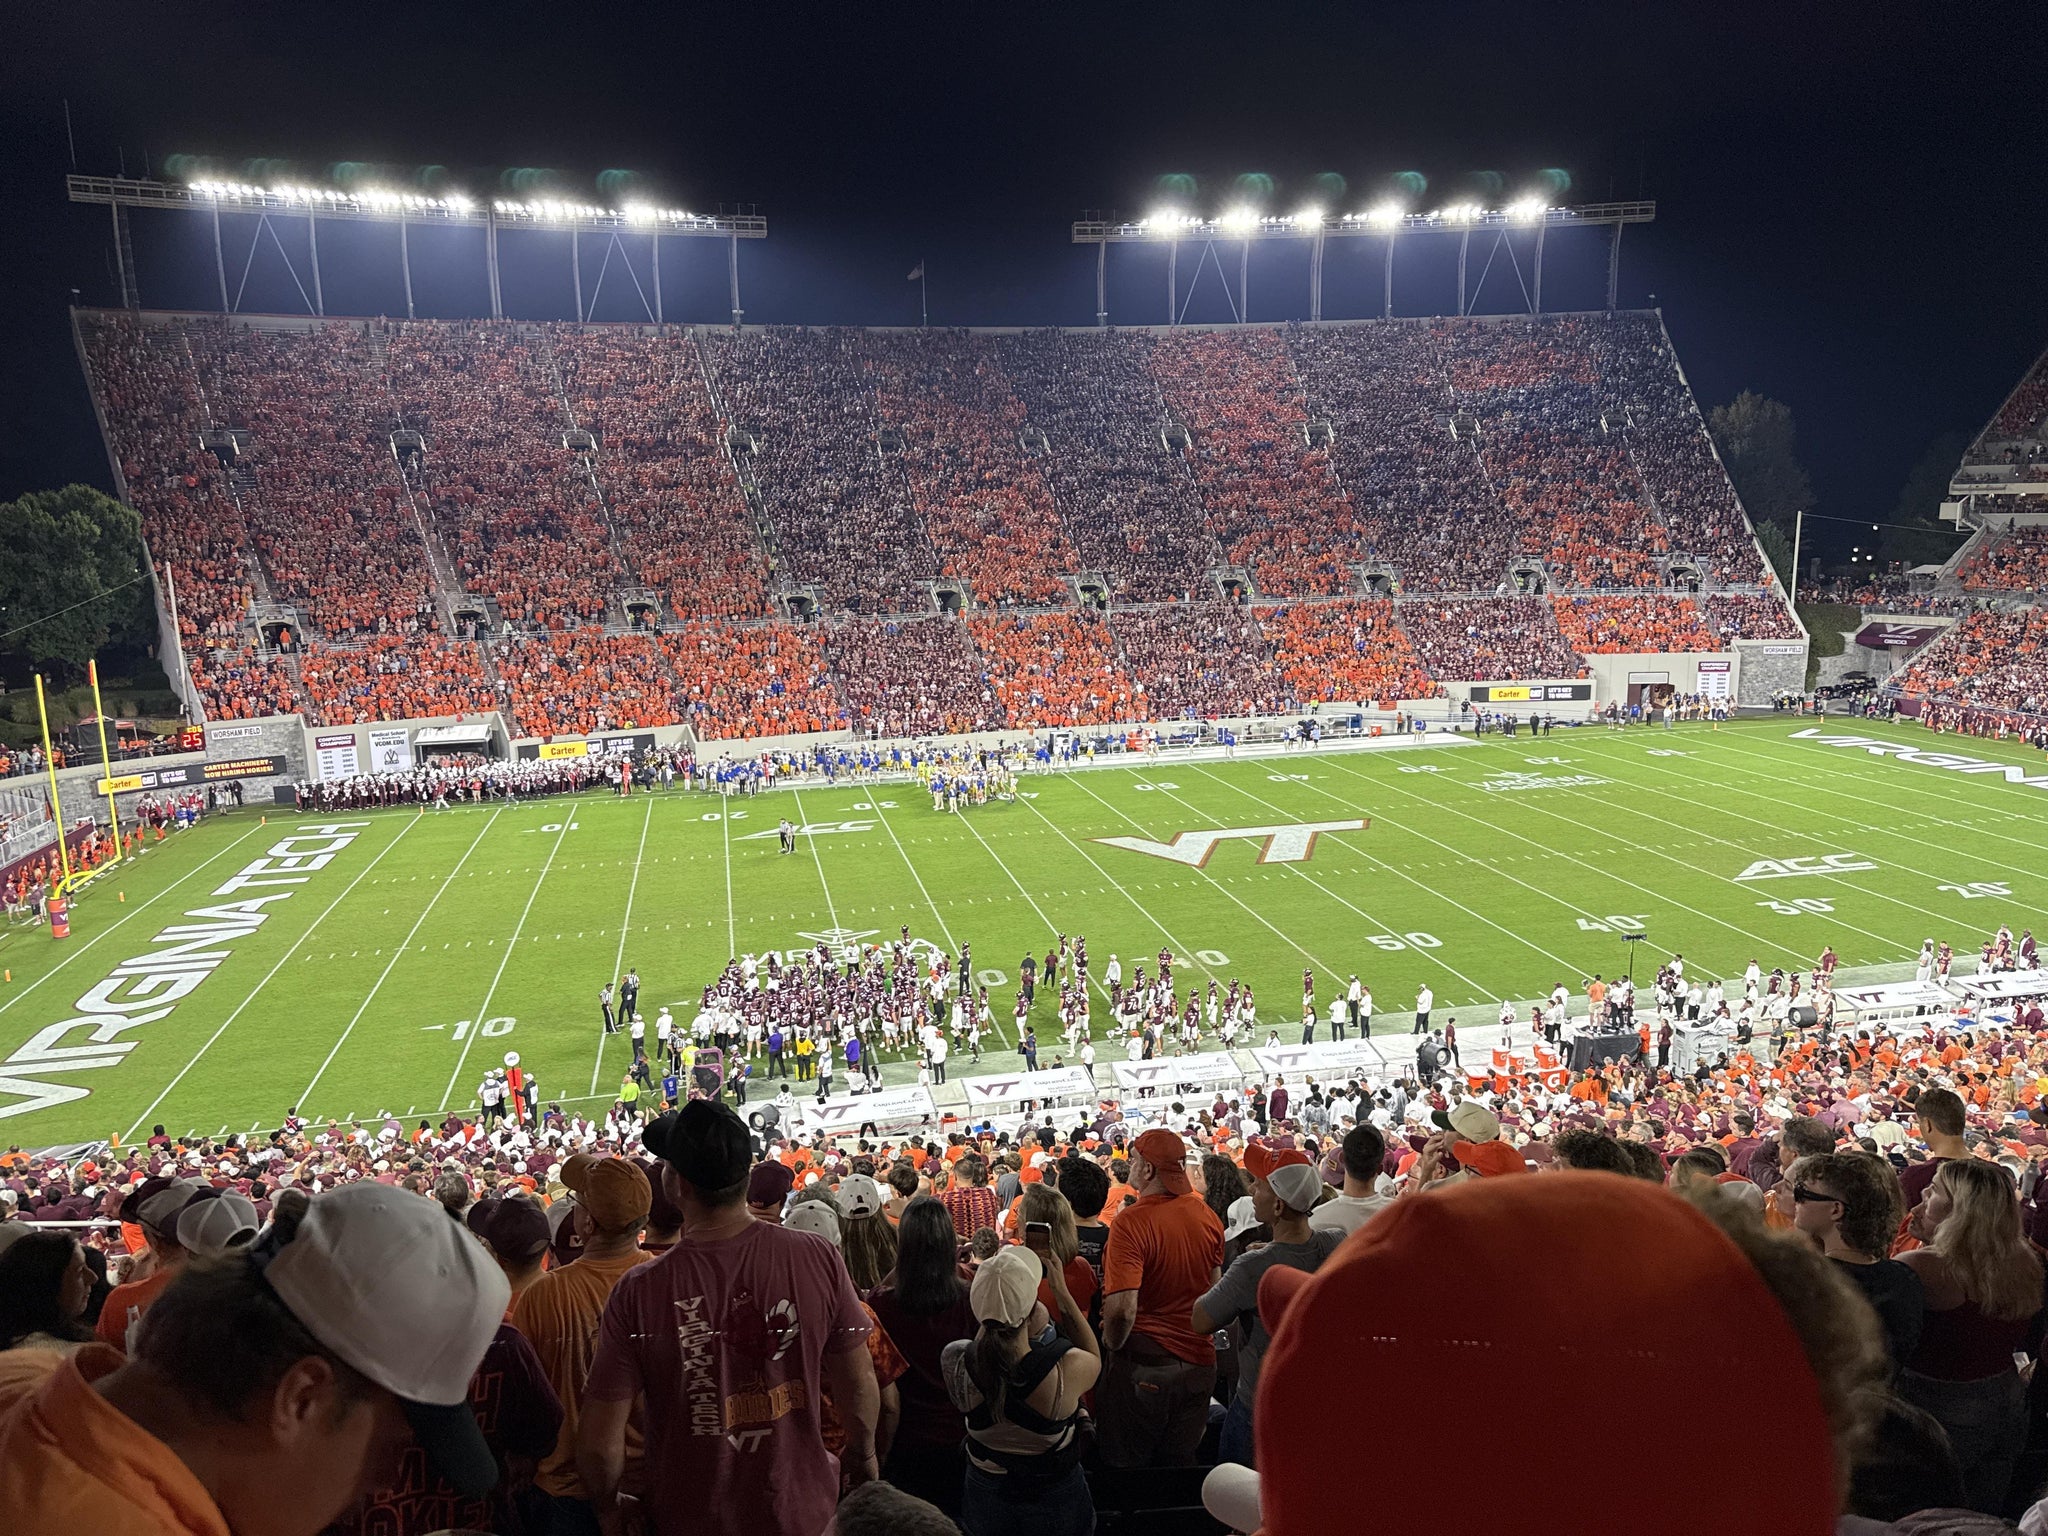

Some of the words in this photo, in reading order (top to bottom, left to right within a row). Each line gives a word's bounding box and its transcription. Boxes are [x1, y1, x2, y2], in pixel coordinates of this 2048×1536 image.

[1885, 624, 1938, 635] VT
[1498, 690, 1520, 698] Carter
[183, 732, 203, 748] 25
[213, 728, 243, 739] WORSHAM
[244, 727, 261, 736] FIELD
[550, 746, 576, 756] Carter
[203, 763, 230, 772] CARTER
[231, 759, 269, 768] MACHINERY
[204, 771, 221, 779] NOW
[222, 769, 246, 777] HIRING
[246, 765, 274, 774] HOKIES!
[540, 822, 580, 832] 10
[1083, 818, 1371, 868] VT
[210, 821, 372, 897] TECH
[1734, 853, 1878, 881] ACC
[1936, 882, 2013, 899] 20
[1576, 915, 1646, 933] 40
[1364, 932, 1443, 950] 50
[1964, 979, 2004, 992] VT
[1845, 991, 1886, 1004] VT
[750, 1014, 761, 1024] 90
[450, 1016, 517, 1041] 10
[1263, 1052, 1308, 1067] VT
[1123, 1064, 1169, 1080] VT
[973, 1080, 1021, 1097] VT
[1547, 1072, 1561, 1089] G
[809, 1102, 862, 1120] VT
[673, 1295, 718, 1392] VIRGINIA
[689, 1392, 723, 1436] TECH
[727, 1428, 774, 1453] VT
